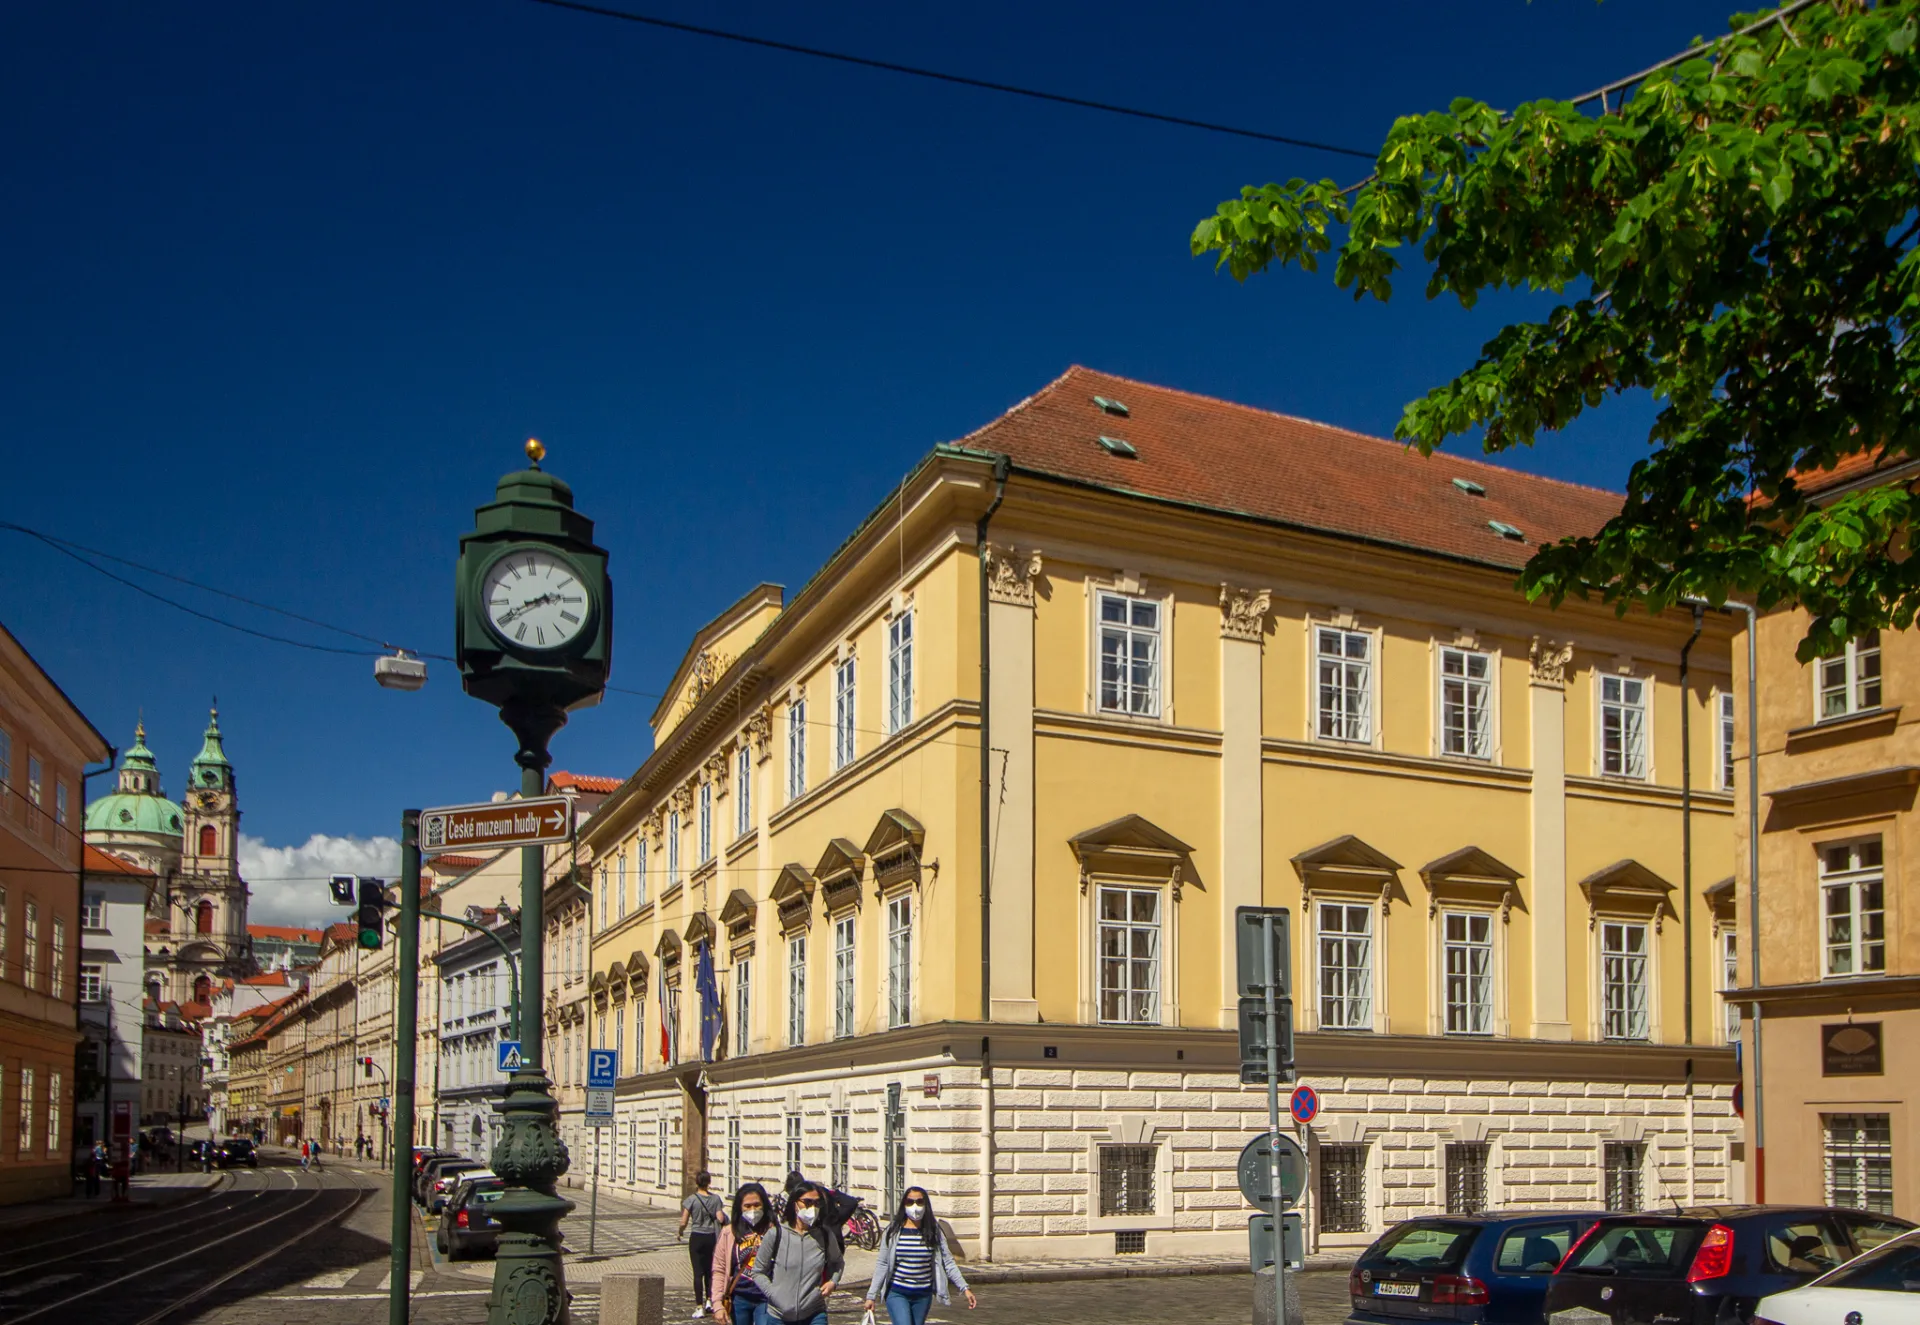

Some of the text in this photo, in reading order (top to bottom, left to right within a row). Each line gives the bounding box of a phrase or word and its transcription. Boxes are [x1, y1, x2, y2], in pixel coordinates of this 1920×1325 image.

[448, 811, 541, 840] České muzeum hudby
[594, 1054, 611, 1077] P
